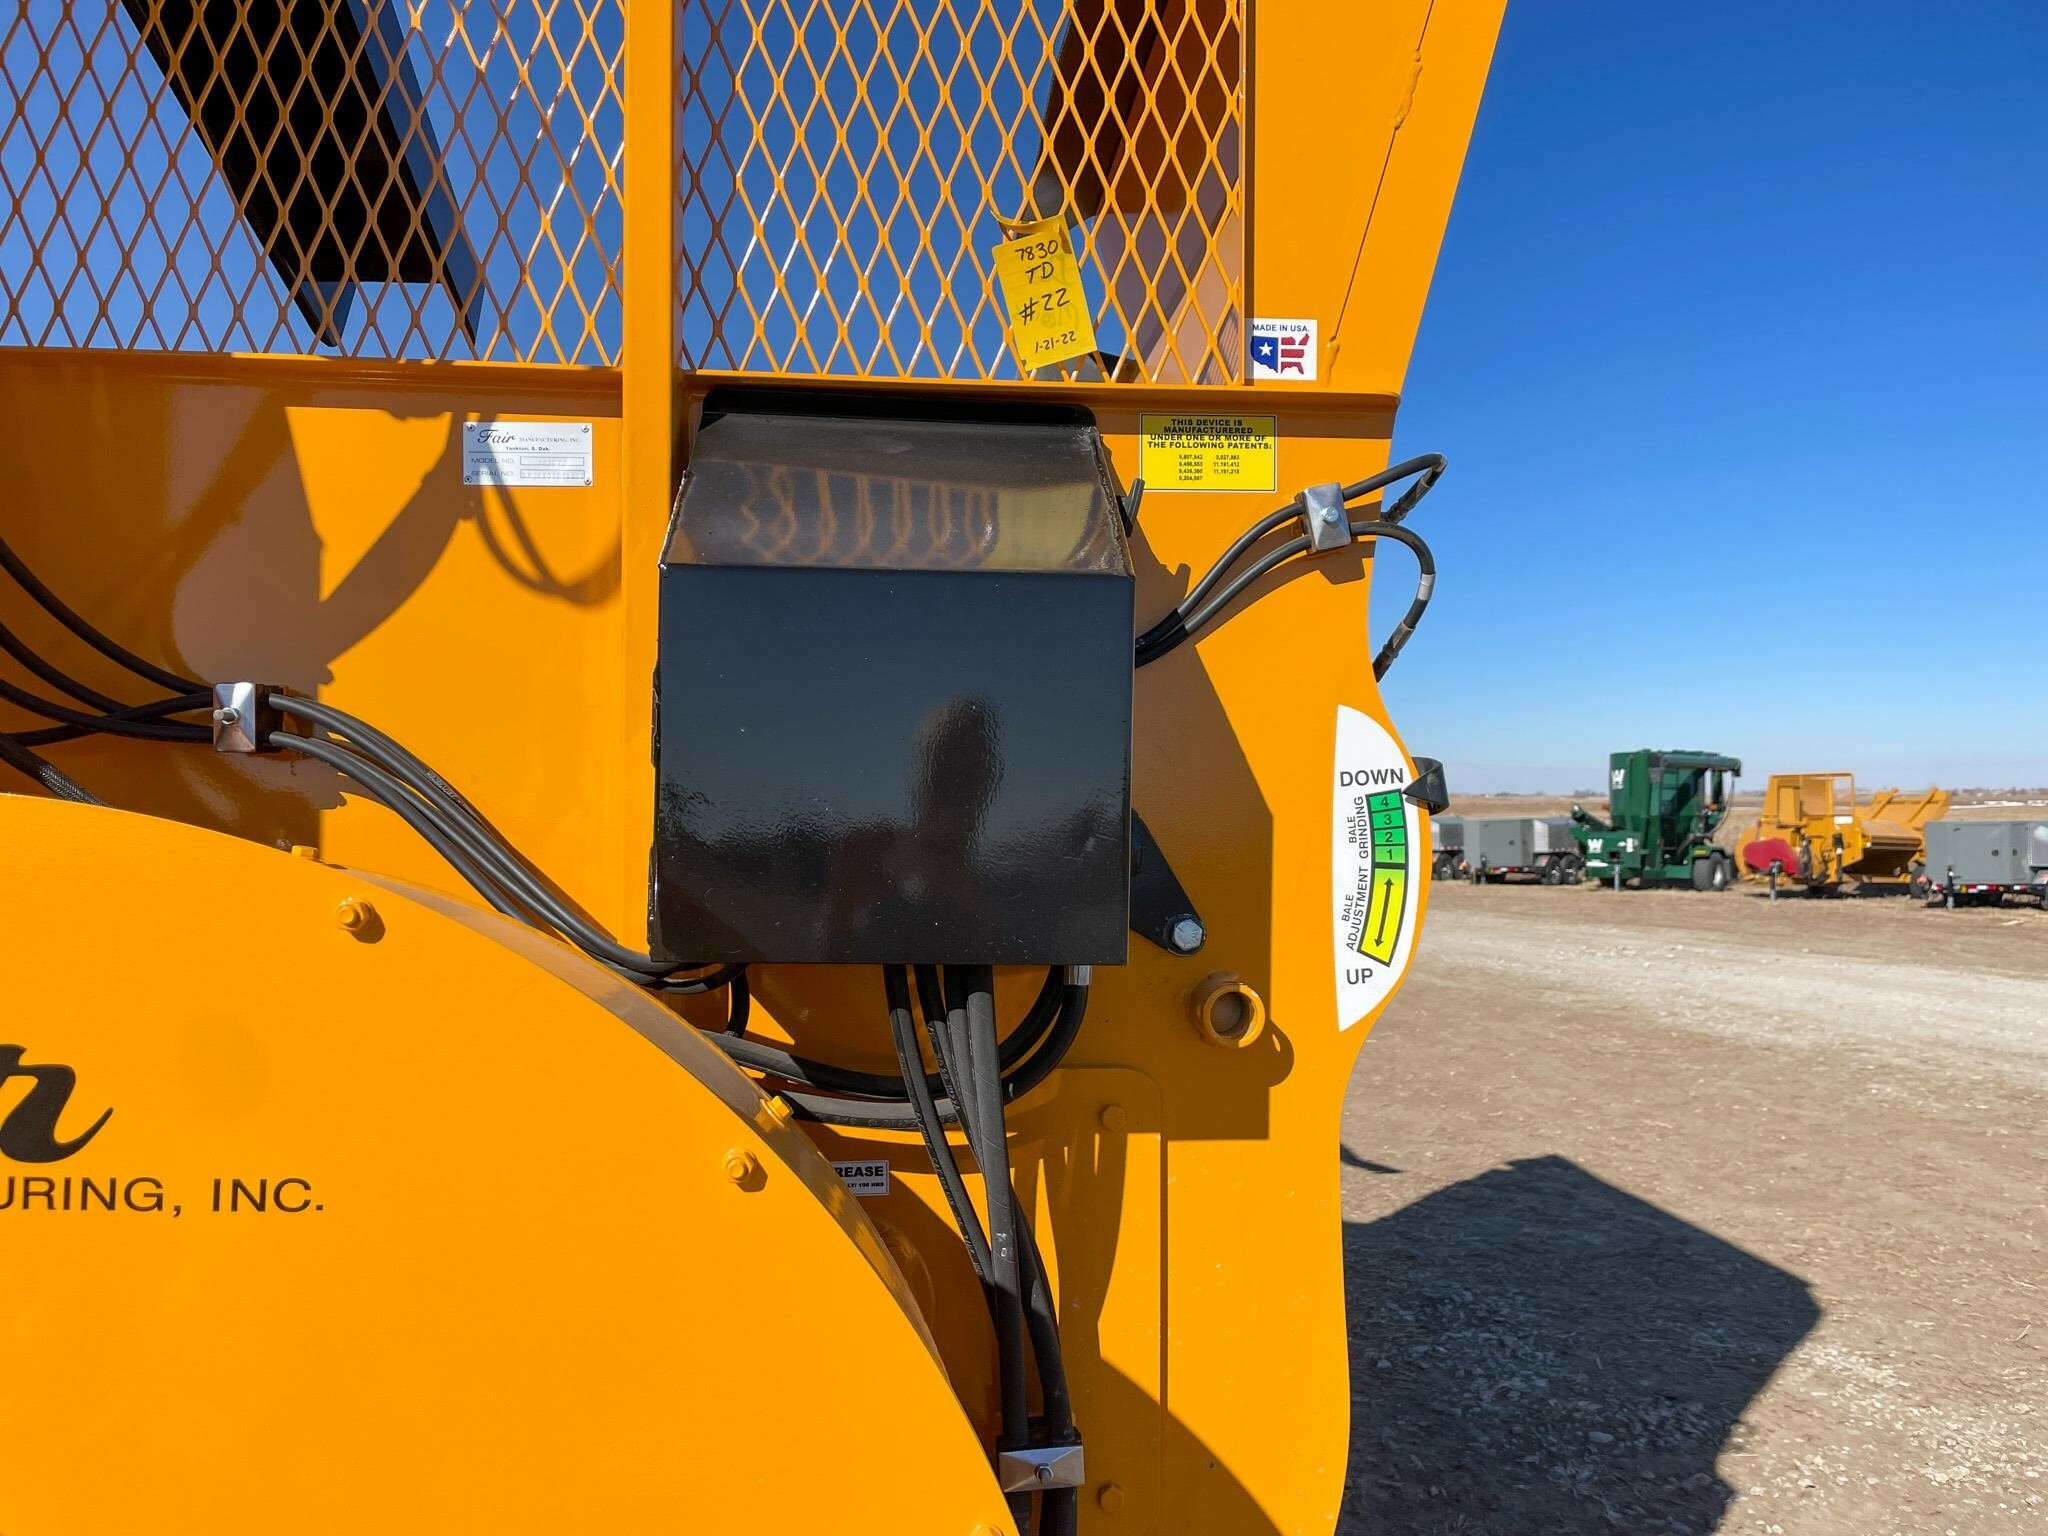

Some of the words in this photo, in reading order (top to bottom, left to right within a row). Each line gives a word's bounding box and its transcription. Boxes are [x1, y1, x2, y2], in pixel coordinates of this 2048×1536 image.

[1015, 240, 1058, 261] 7830
[1026, 262, 1054, 284] TD
[1019, 288, 1070, 326] #22
[1035, 331, 1077, 353] 1-21-22
[477, 429, 517, 443] Fair
[1150, 433, 1183, 441] UNDER
[1186, 433, 1205, 441] ONE
[1225, 434, 1251, 442] MORE
[1255, 434, 1267, 442] OF
[1163, 426, 1253, 434] MANUFACTURERED
[1170, 441, 1224, 449] FOLLOWING
[1340, 768, 1404, 787] DOWN
[1381, 797, 1390, 808] 4
[1347, 815, 1357, 843] BALE
[1353, 796, 1369, 859] GRINDING
[1384, 814, 1392, 825] 3
[1385, 831, 1393, 842] 2
[1386, 849, 1393, 860] 1
[1341, 894, 1354, 922] BALE
[1346, 866, 1368, 951] ADJUSTMENT
[1346, 968, 1373, 985] UP
[212, 1178, 324, 1212] INC.
